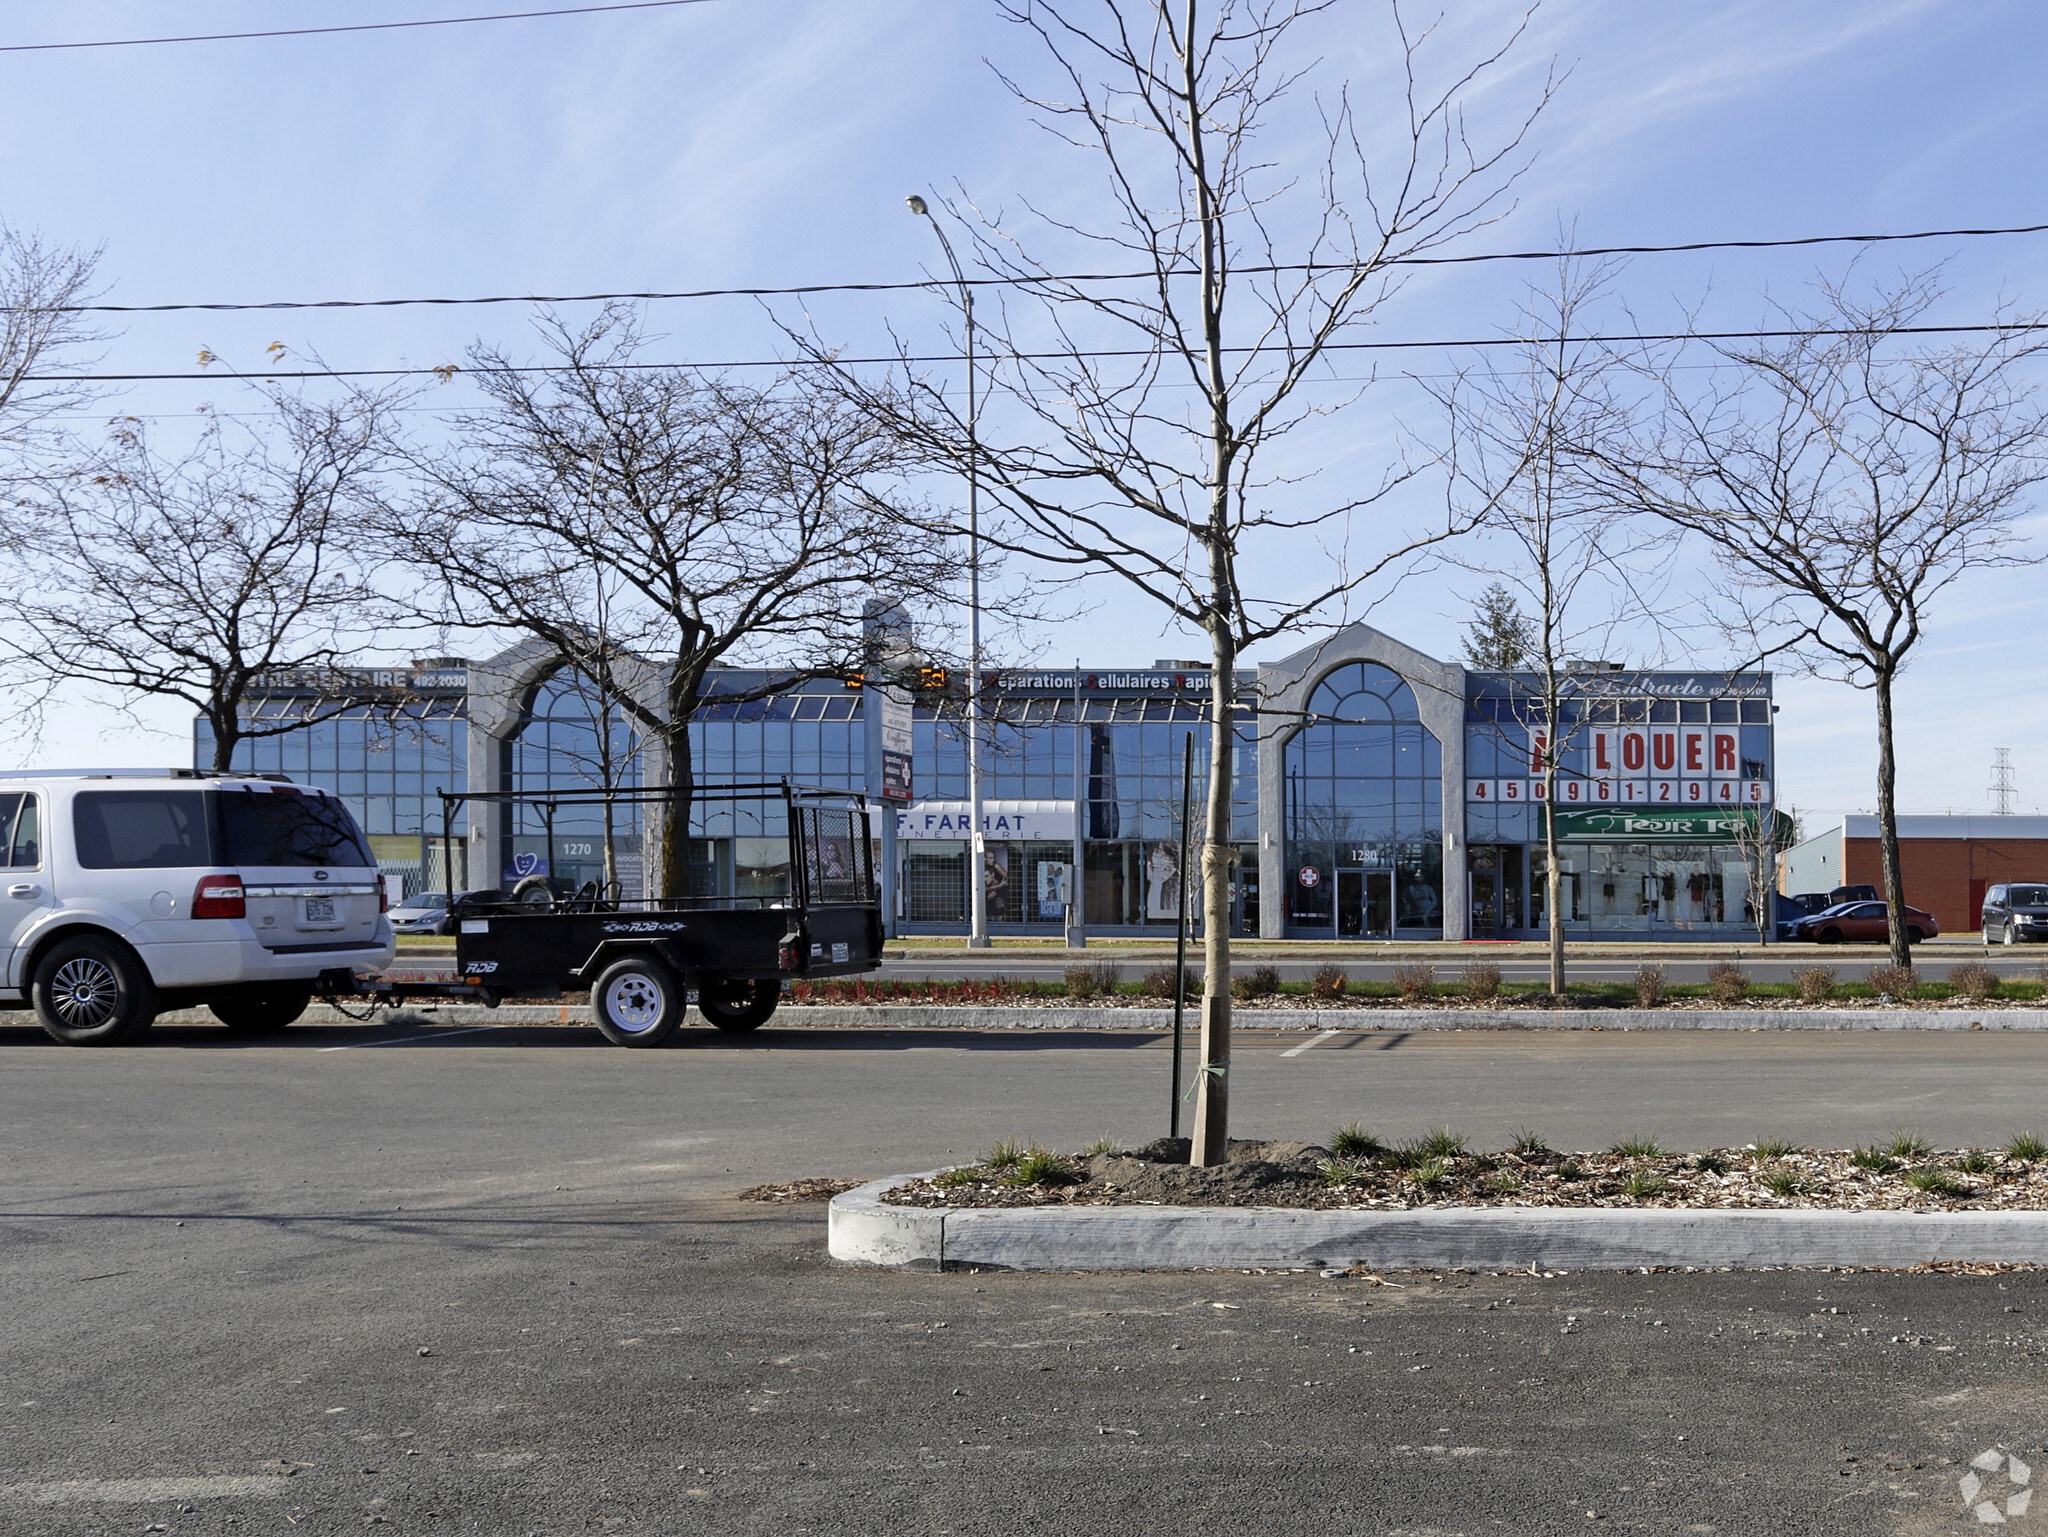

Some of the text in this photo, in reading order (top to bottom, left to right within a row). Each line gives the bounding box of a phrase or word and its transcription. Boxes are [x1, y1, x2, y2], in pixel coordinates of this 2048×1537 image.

[1087, 673, 1170, 689] Cellulaires
[1174, 673, 1238, 692] Rapis
[1595, 732, 1736, 771] LOUER
[880, 831, 1042, 839] UNETERIE
[563, 843, 592, 855] 1270
[1352, 850, 1377, 861] 1280
